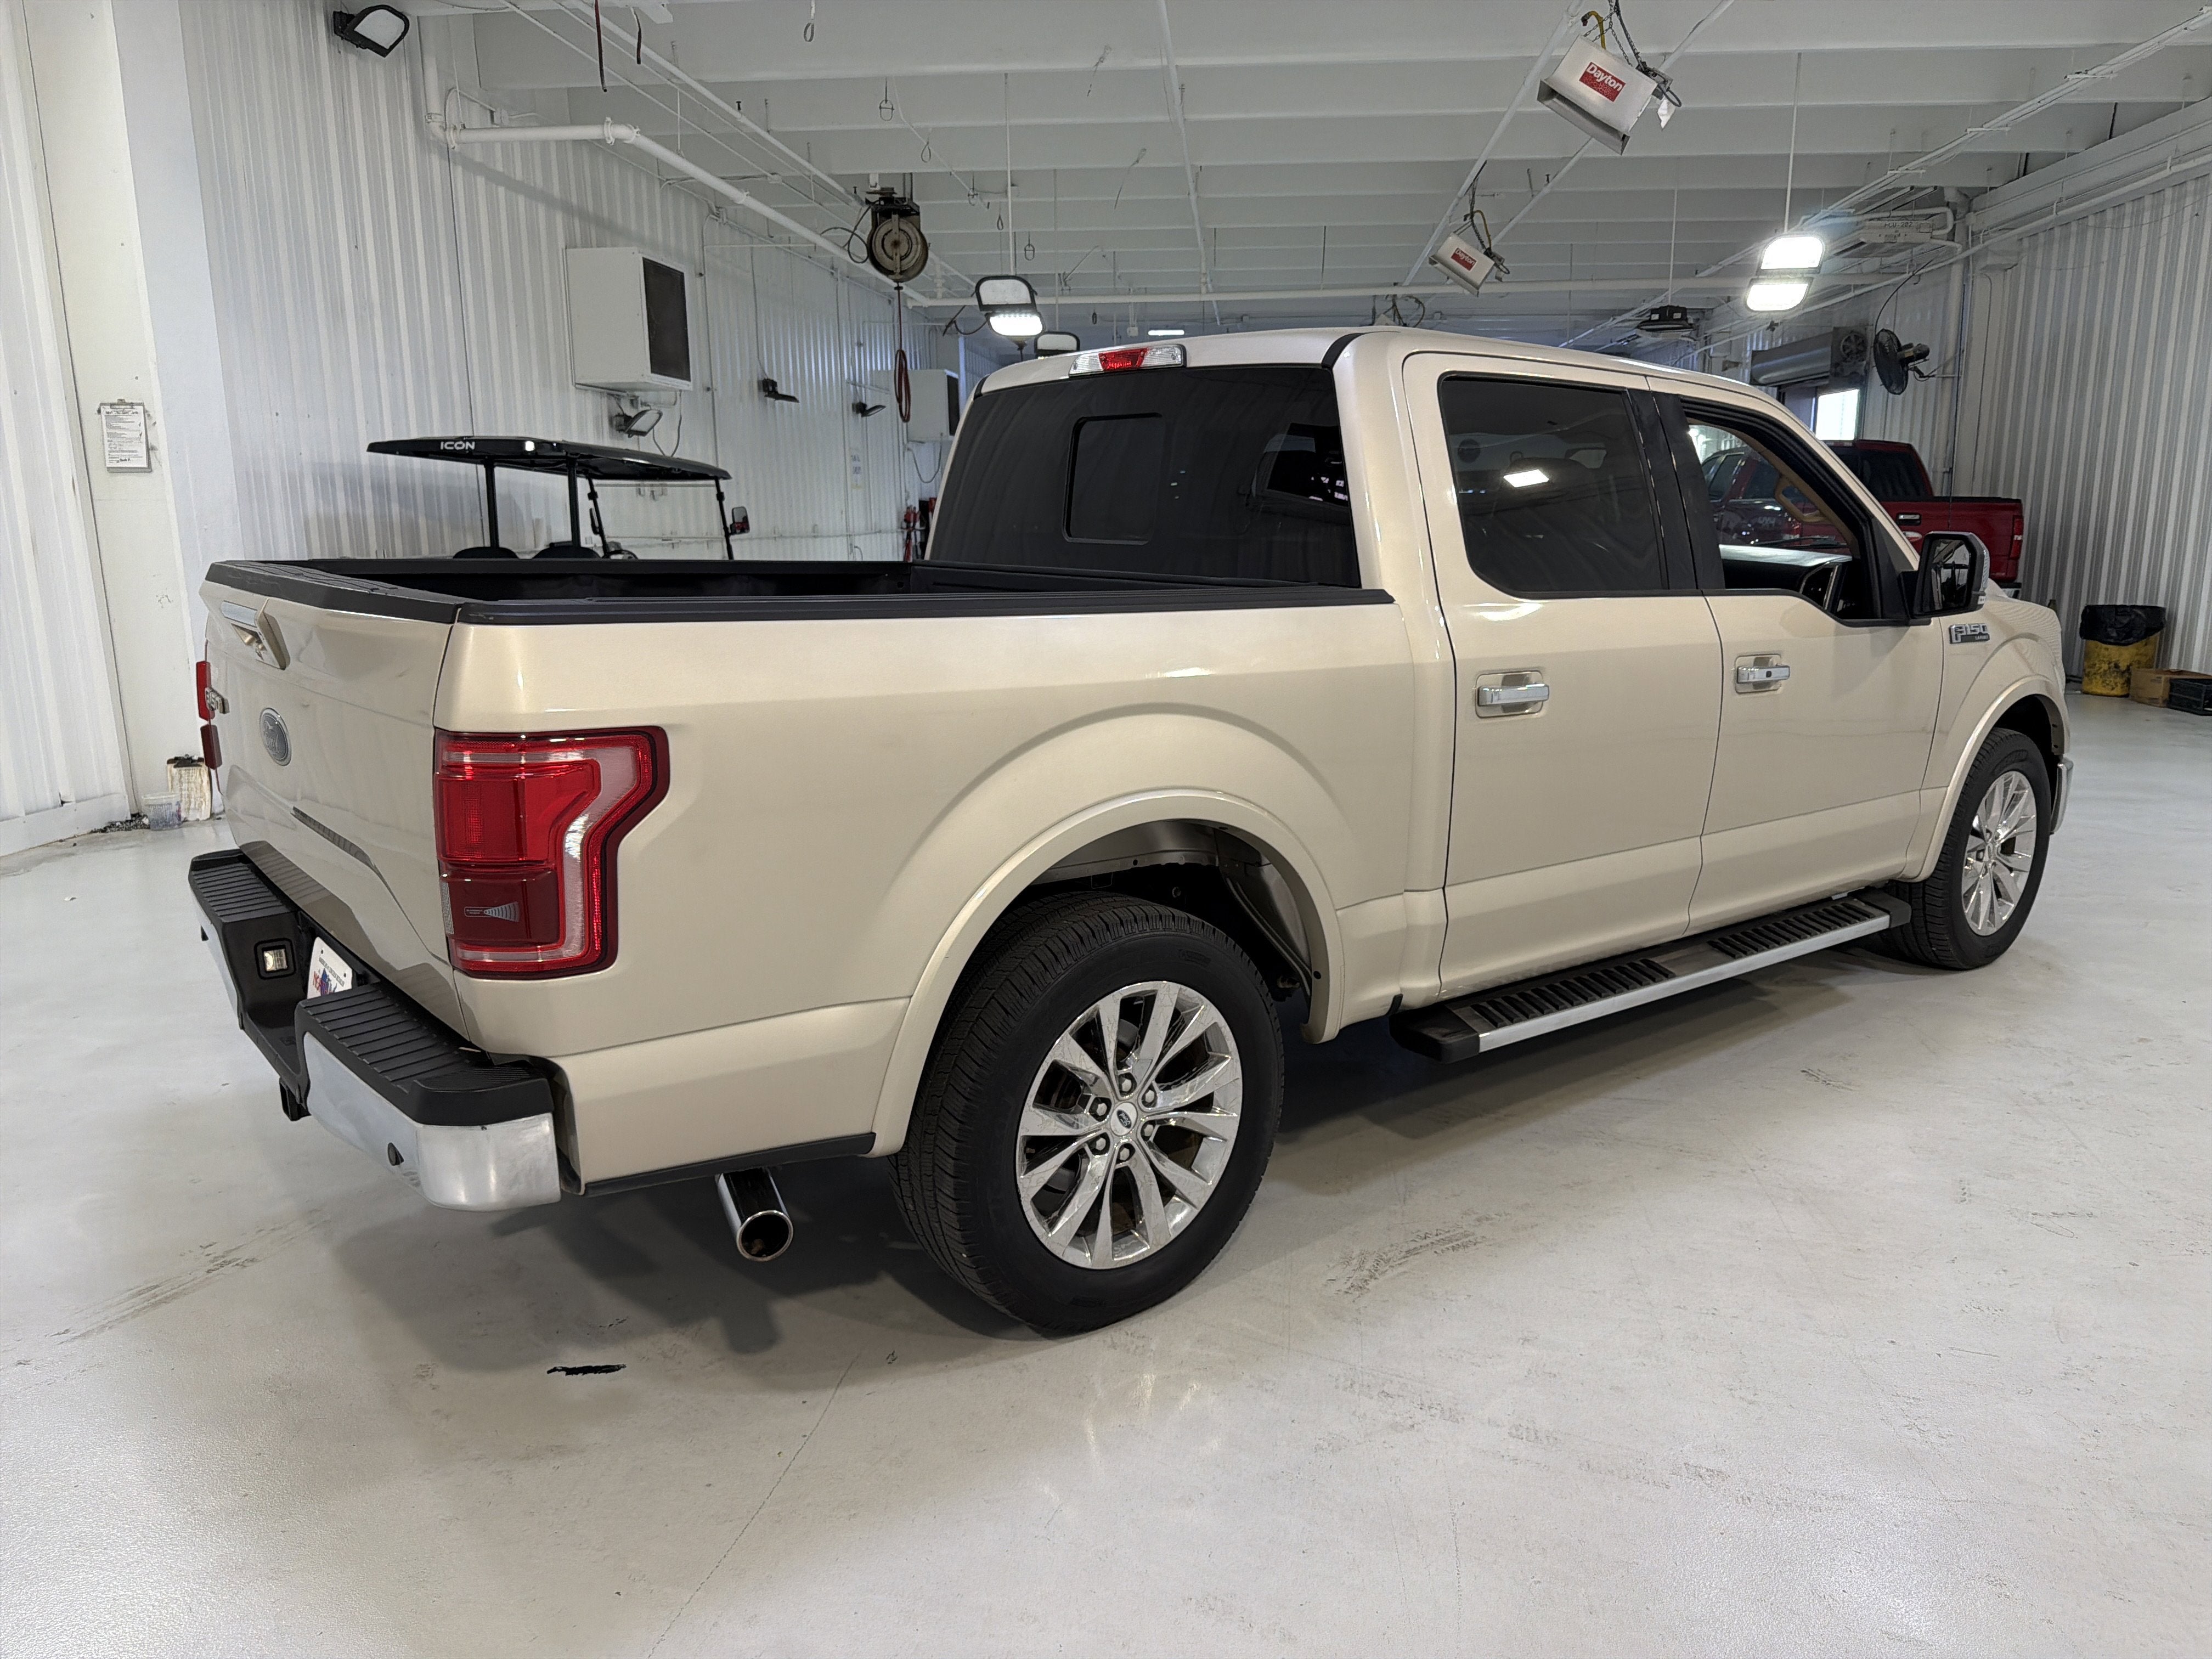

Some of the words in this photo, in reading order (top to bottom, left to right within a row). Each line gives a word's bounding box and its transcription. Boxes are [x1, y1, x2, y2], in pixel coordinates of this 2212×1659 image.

[1587, 64, 1623, 92] Dayton
[1455, 249, 1475, 266] Dayton
[441, 441, 475, 450] ICON
[1119, 1112, 1131, 1126] Ford
